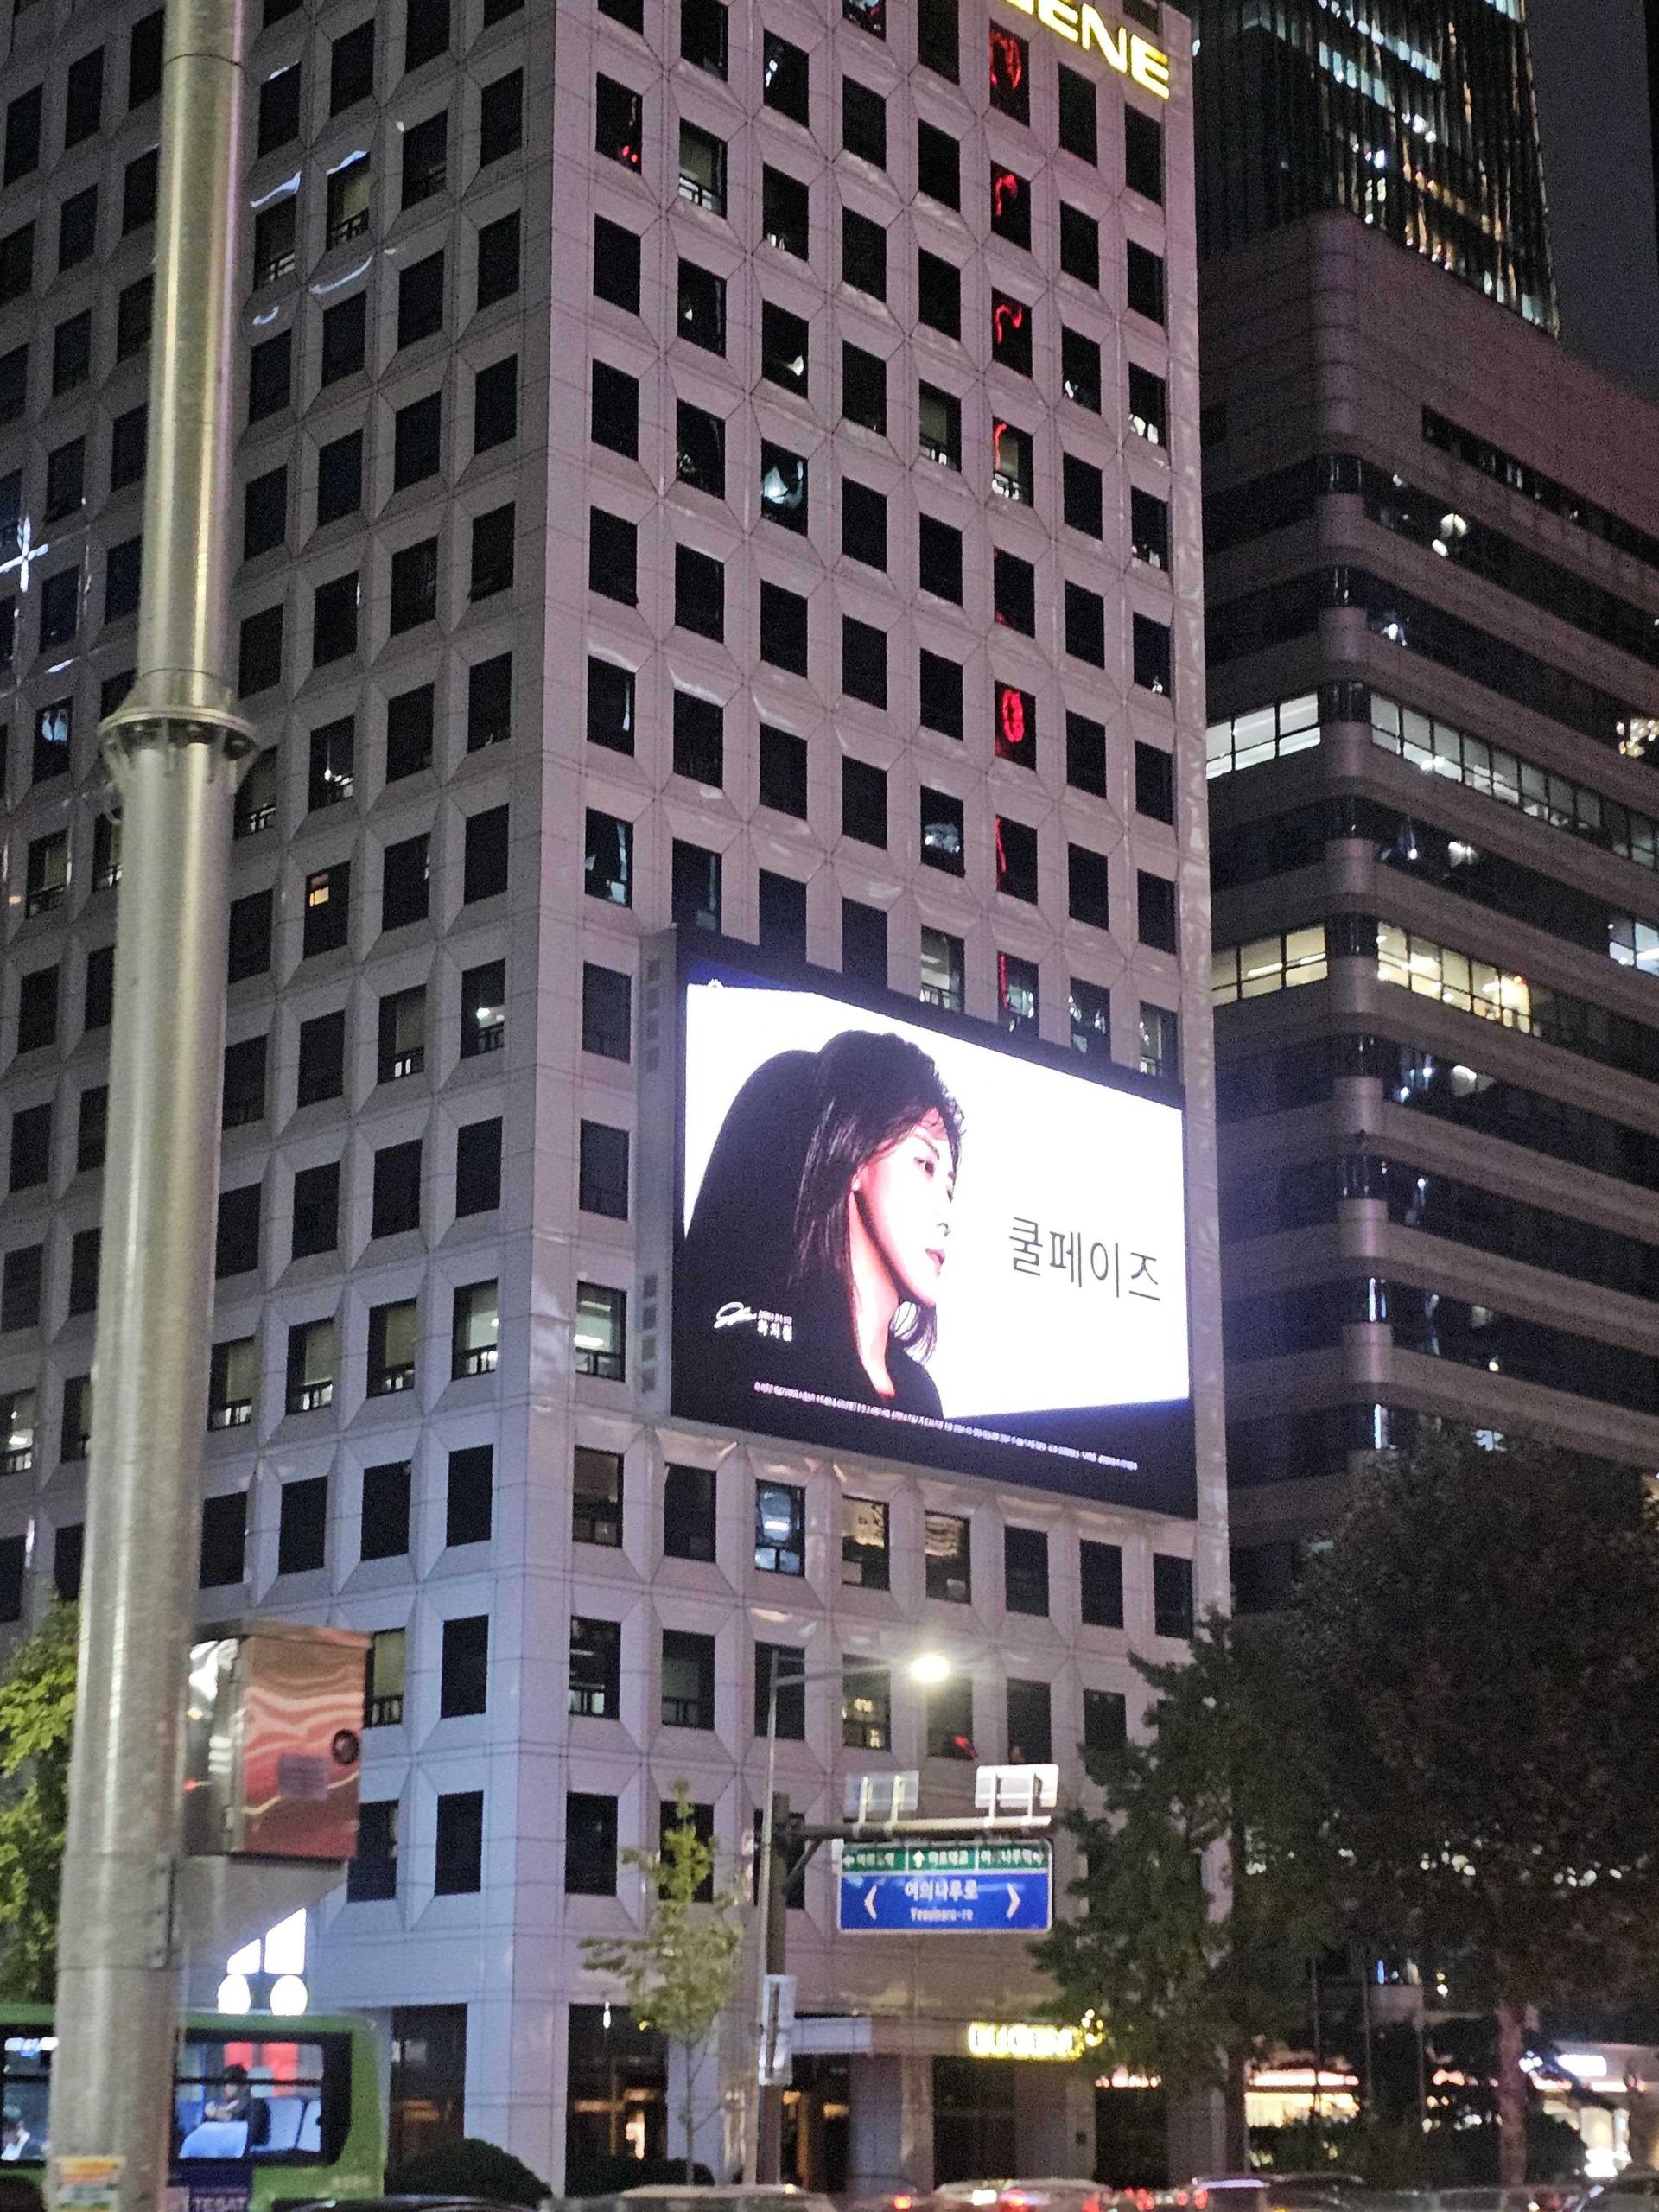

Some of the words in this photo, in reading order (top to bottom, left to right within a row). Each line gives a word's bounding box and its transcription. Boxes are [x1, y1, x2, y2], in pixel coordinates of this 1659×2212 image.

[1004, 0, 1170, 100] ENE
[1008, 1217, 1161, 1302] 쿨페이즈
[905, 1879, 978, 1901] 여의나루로
